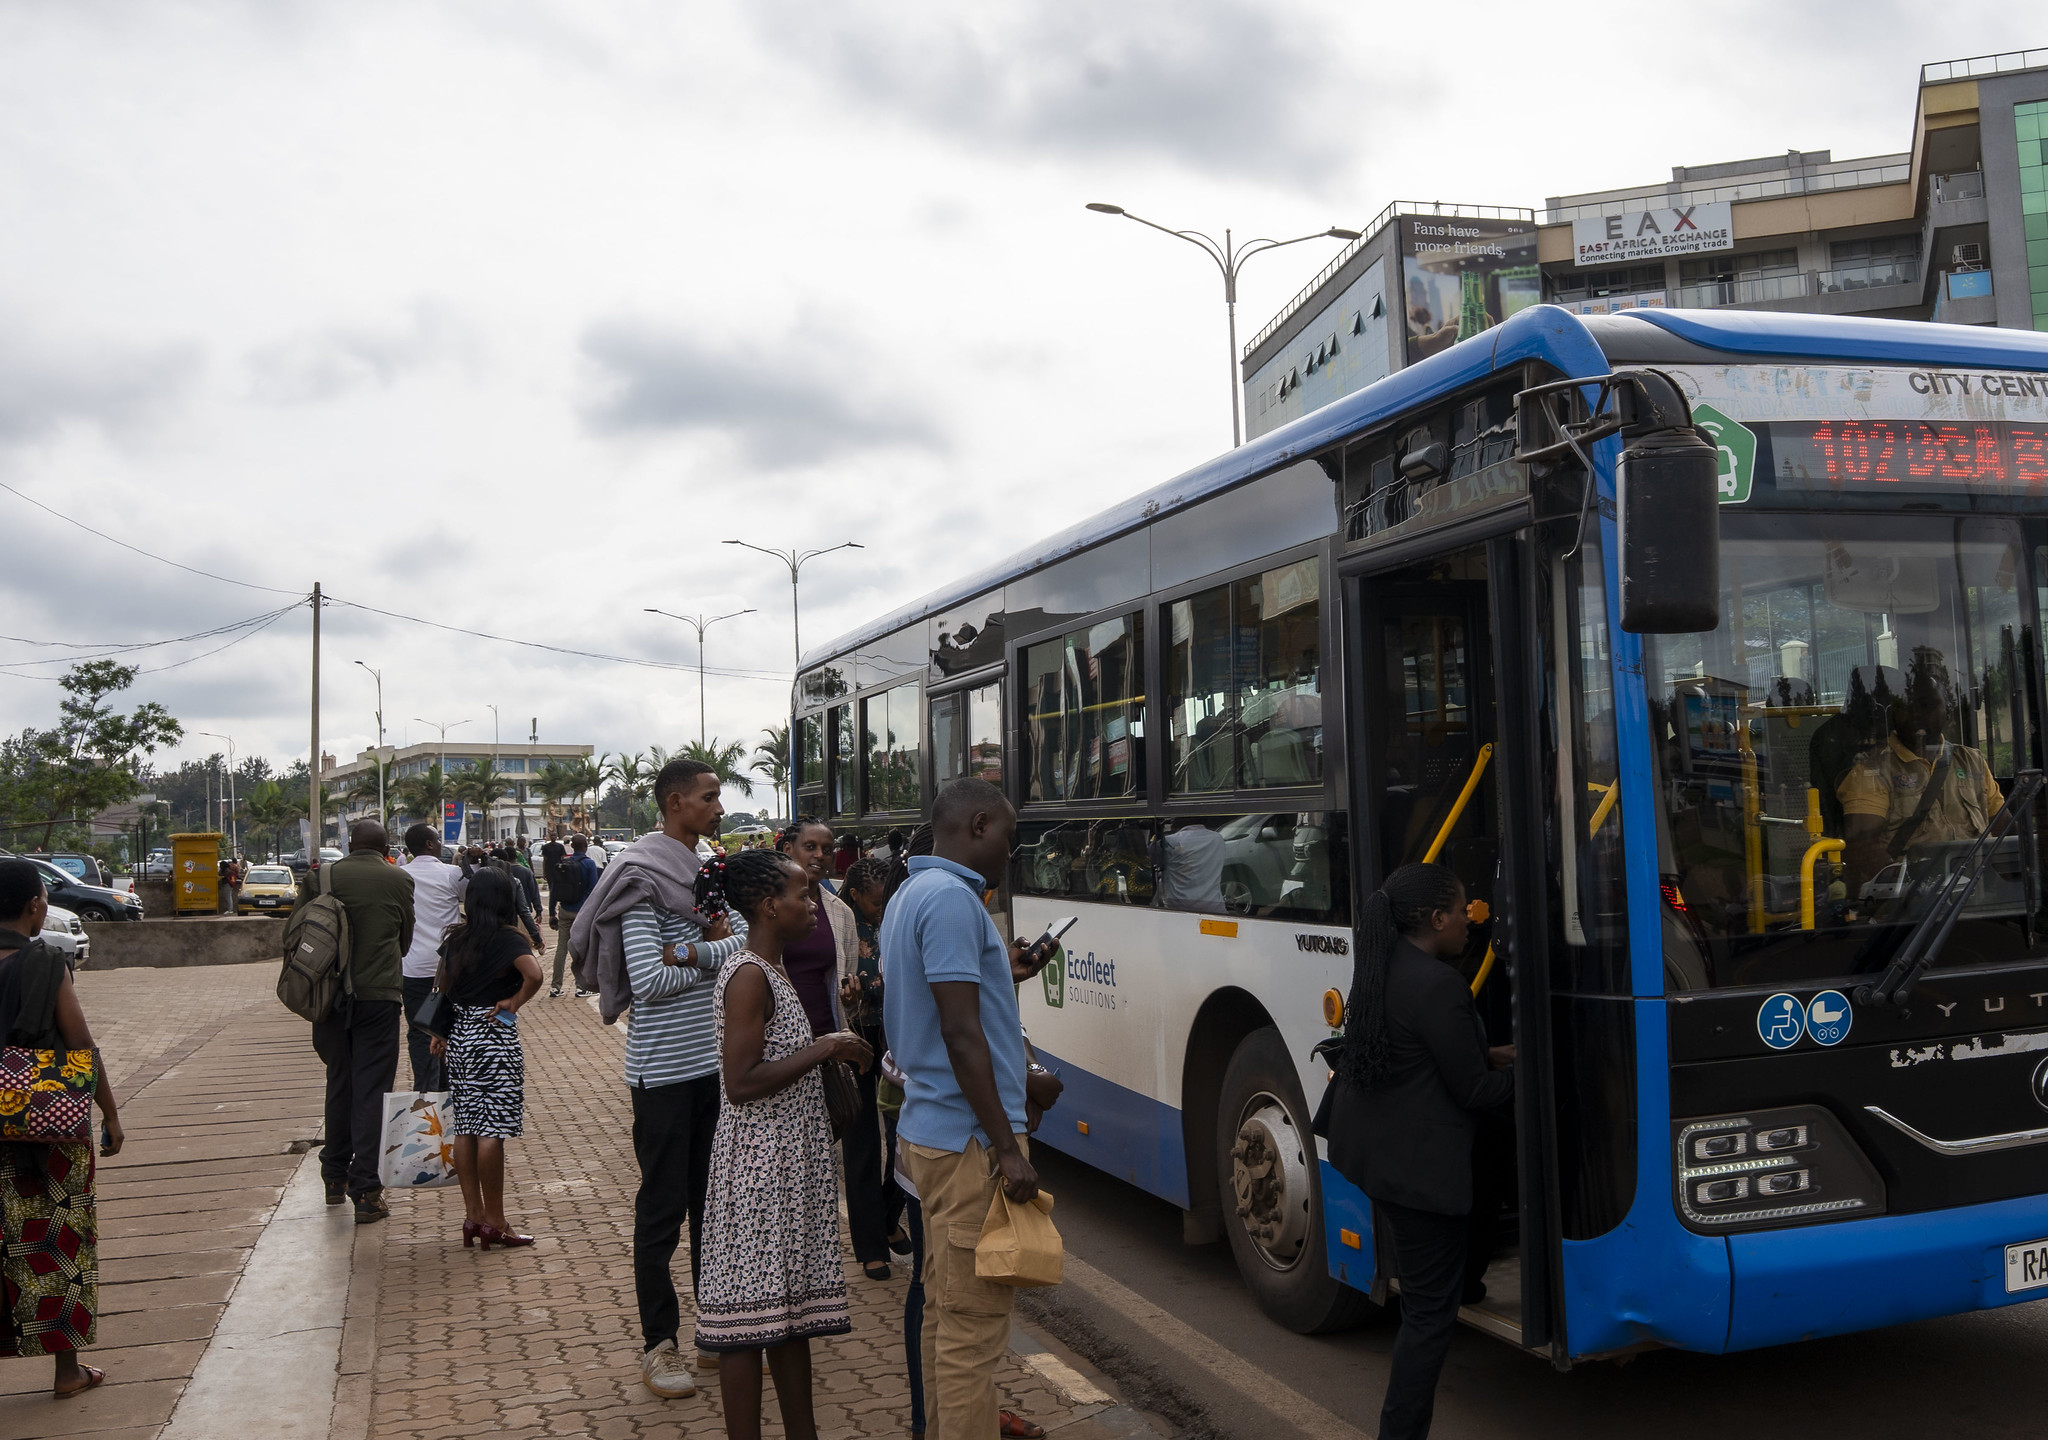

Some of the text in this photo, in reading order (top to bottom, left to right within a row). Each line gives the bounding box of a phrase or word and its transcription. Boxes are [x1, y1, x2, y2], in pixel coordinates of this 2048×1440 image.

[1413, 221, 1480, 237] Fans have
[1606, 206, 1697, 240] EAX
[1415, 241, 1506, 256] more friends.
[1580, 229, 1728, 254] EAST AFRICA EXCHANGE
[1580, 239, 1728, 263] Connecting markets Growing trade
[1591, 305, 1607, 313] PIL
[1649, 299, 1664, 307] PIL
[1908, 372, 2048, 397] CITY CENT
[1812, 420, 1900, 483] 102
[1295, 933, 1350, 956] YUTONG
[1067, 949, 1116, 987] Ecofleet
[1069, 986, 1116, 1010] SOLUTIONS
[1936, 992, 2048, 1017] YUT
[2023, 1247, 2048, 1283] RA
